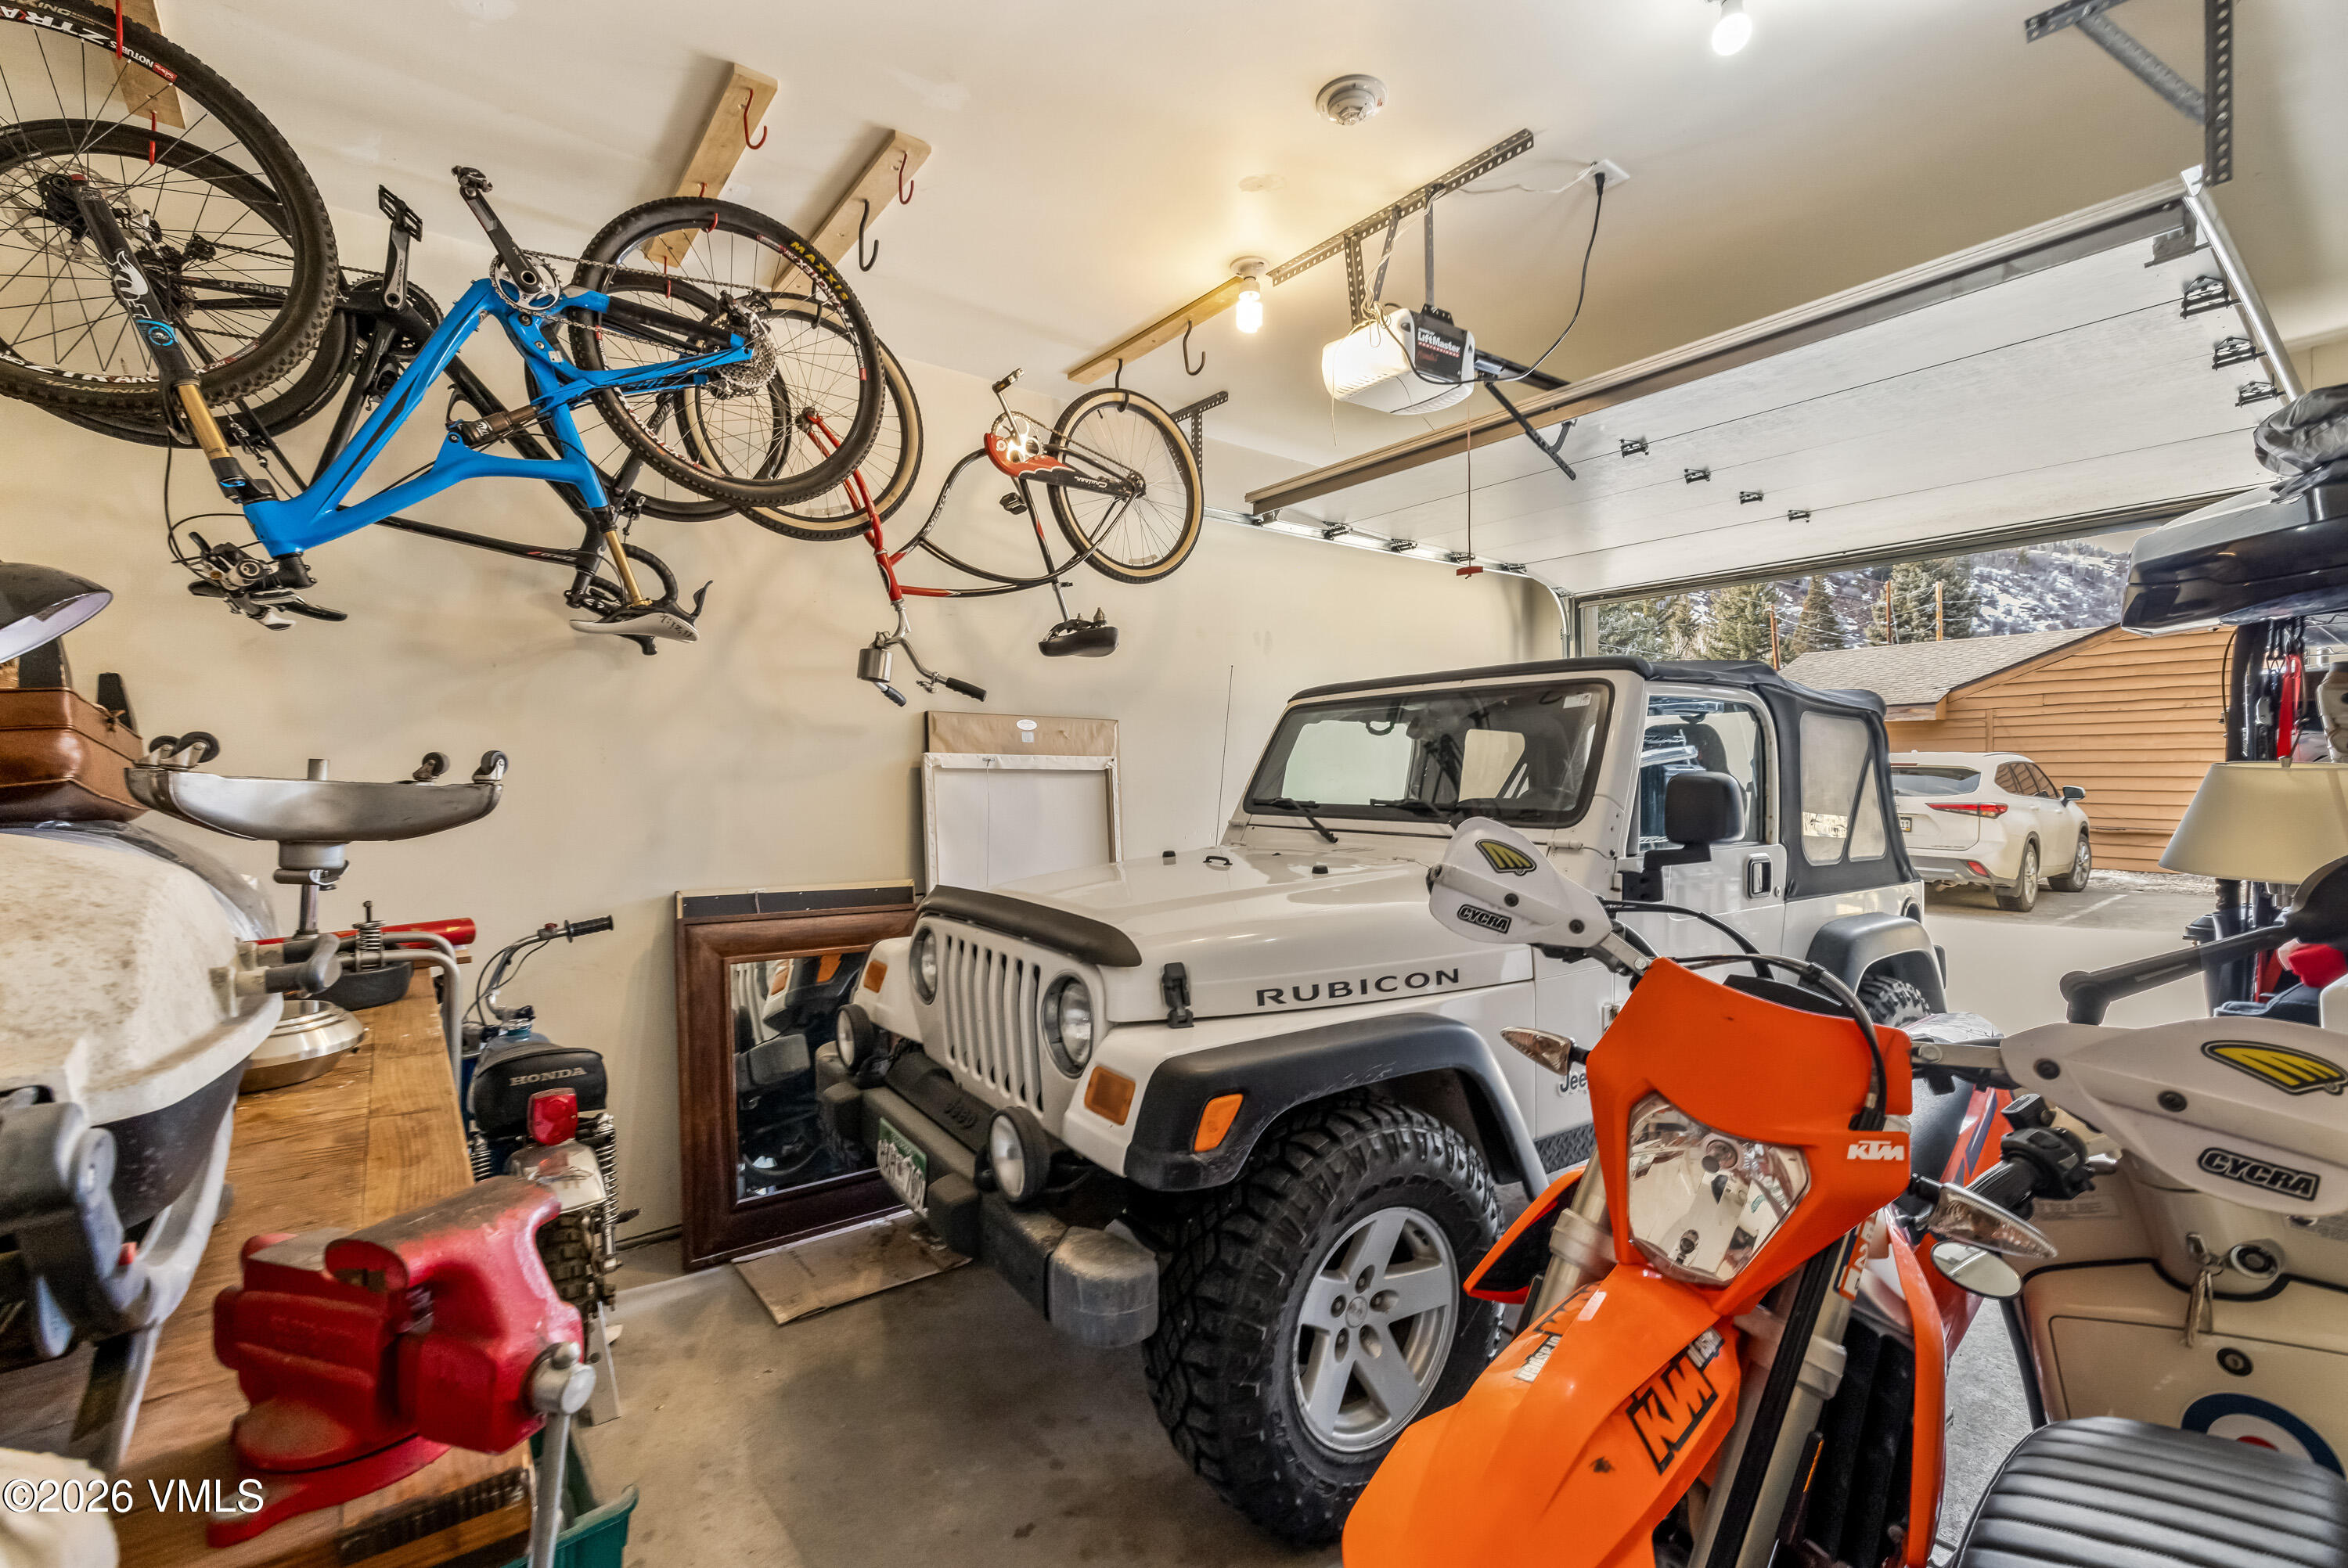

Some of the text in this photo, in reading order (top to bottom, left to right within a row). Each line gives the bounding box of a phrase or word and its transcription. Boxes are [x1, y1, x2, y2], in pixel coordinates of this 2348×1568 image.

[110, 41, 154, 68] NOTUBS
[790, 241, 849, 300] MAXXIS
[1417, 331, 1460, 354] LiftMaster
[1458, 906, 1510, 931] CYCRA
[1256, 968, 1459, 1007] RUBICON
[509, 1066, 588, 1087] HONDA
[1560, 1072, 1587, 1093] Jee
[1847, 1140, 1905, 1161] KTM
[2202, 1151, 2316, 1196] CYCRA
[1626, 1355, 1719, 1476] KTM
